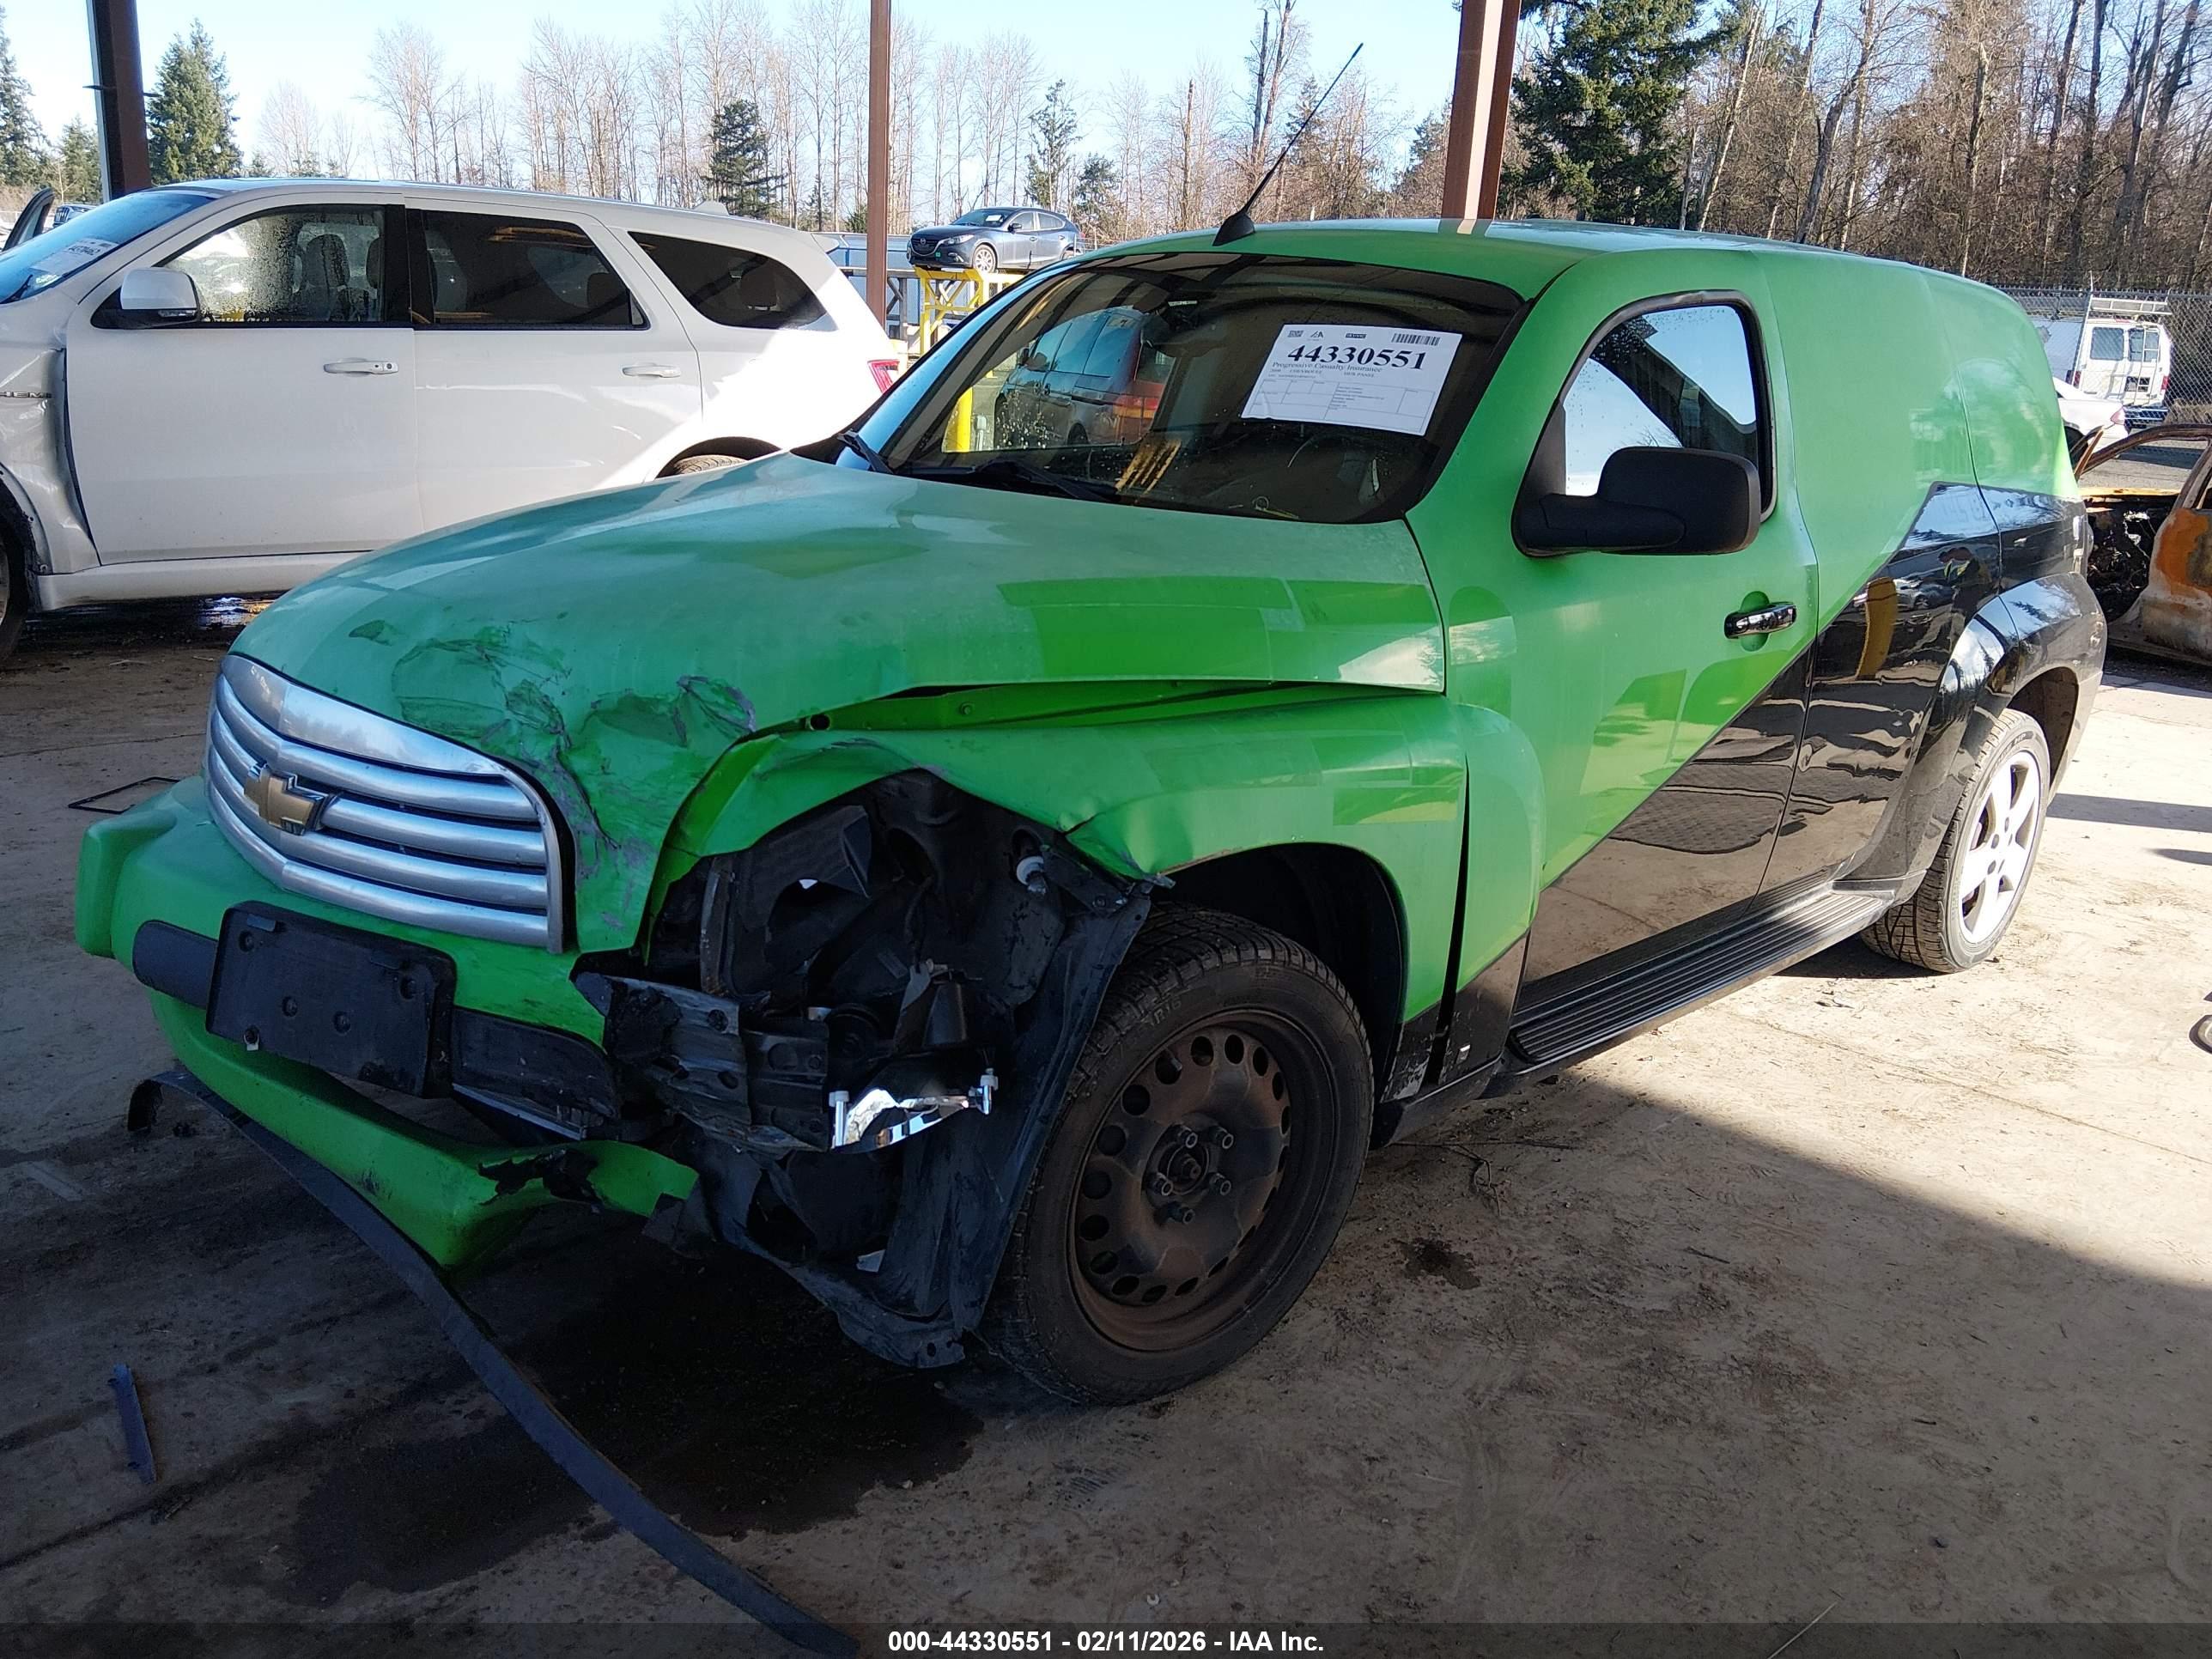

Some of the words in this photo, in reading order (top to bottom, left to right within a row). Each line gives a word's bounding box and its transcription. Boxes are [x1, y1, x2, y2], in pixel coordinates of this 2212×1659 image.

[1287, 344, 1426, 370] 44330551
[1272, 362, 1313, 370] Progressive
[1315, 362, 1344, 372] Casualty
[1346, 364, 1382, 374] Insurance
